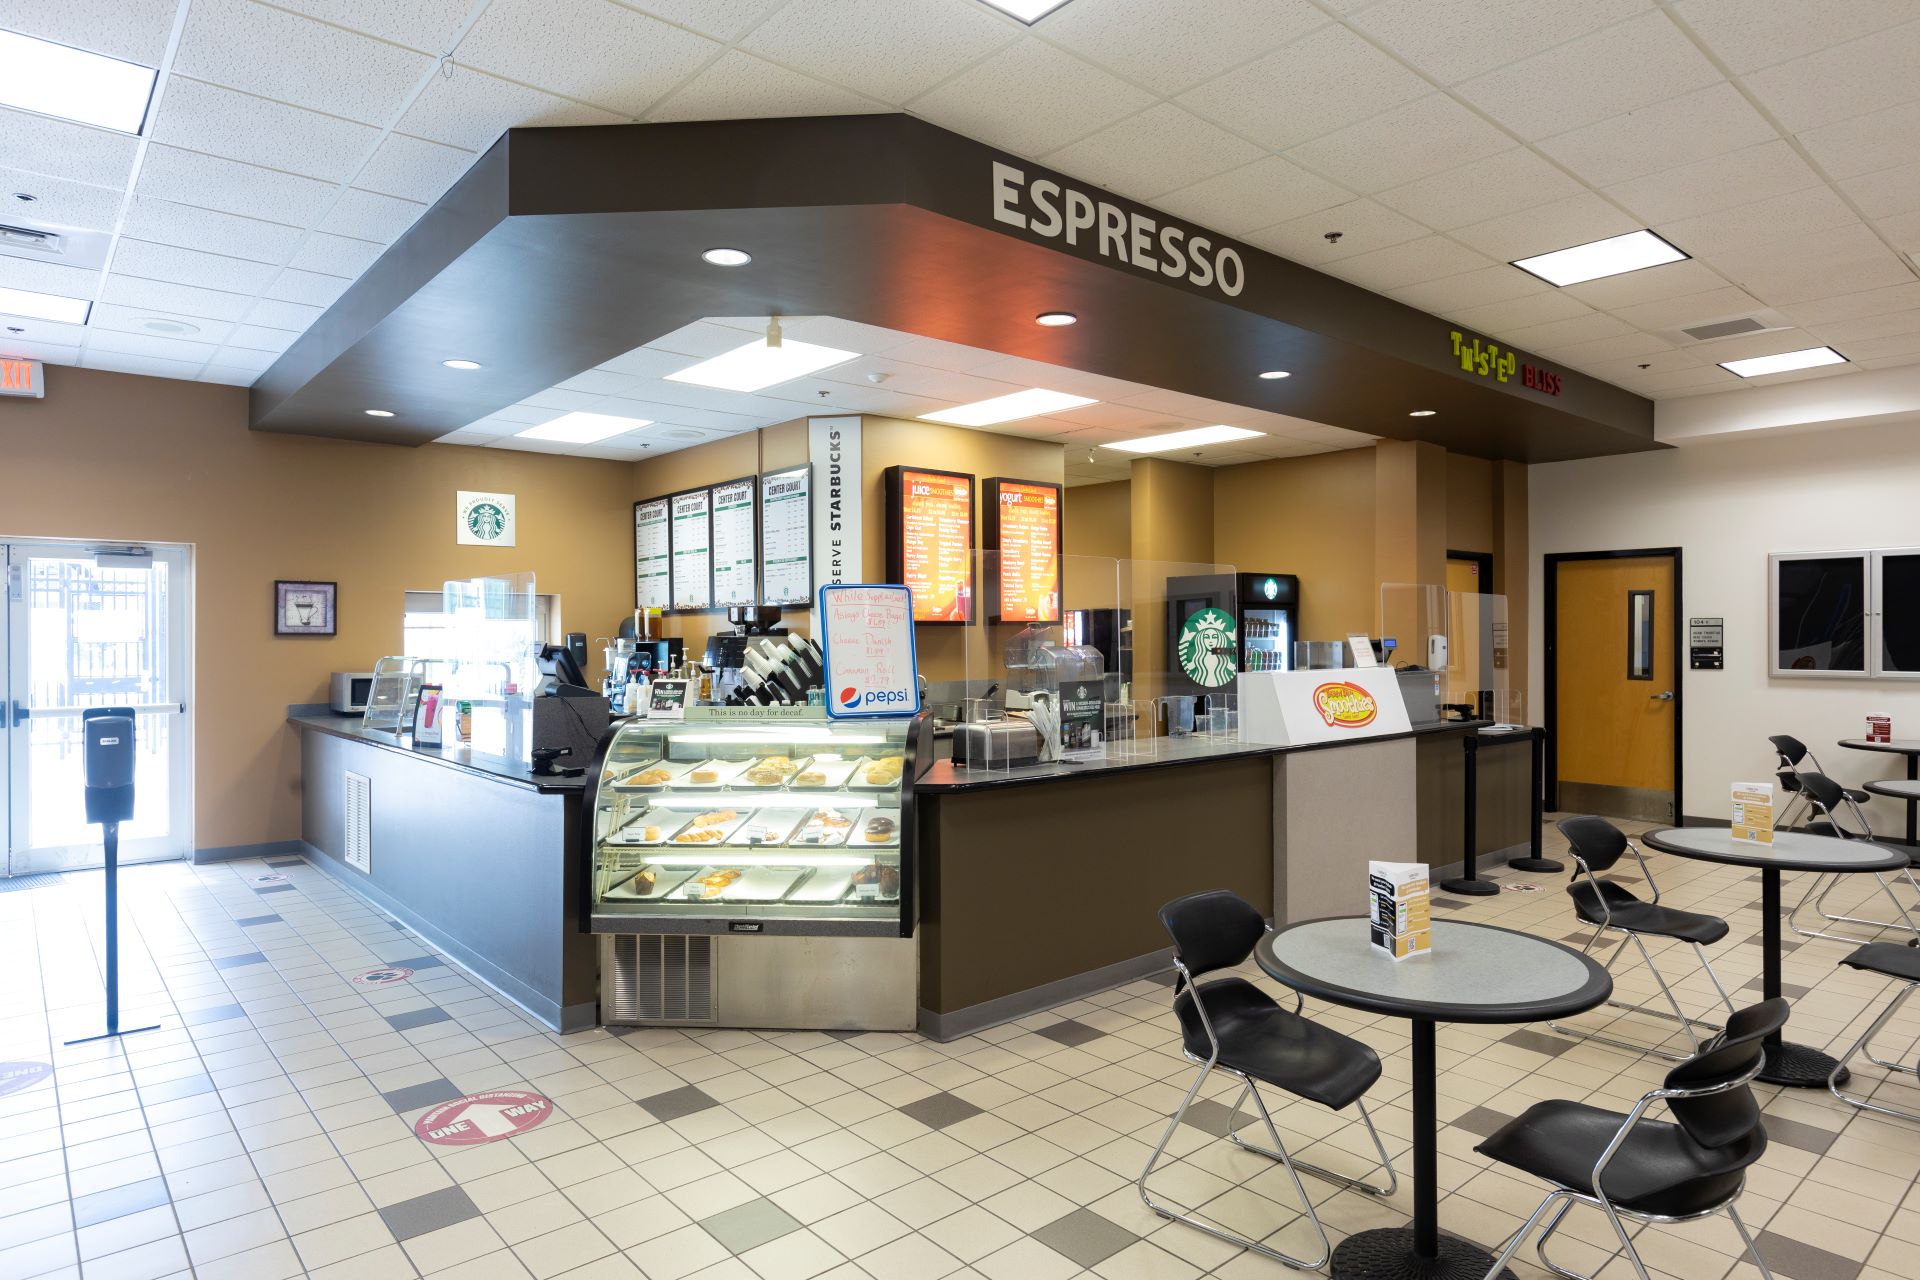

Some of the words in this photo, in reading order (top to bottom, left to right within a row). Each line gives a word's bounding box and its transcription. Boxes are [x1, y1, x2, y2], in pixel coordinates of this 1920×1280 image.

[993, 161, 1245, 297] ESPRESSO
[1450, 331, 1516, 383] TWISTED
[1522, 364, 1561, 396] BLISS
[0, 360, 32, 391] XIT
[768, 483, 786, 496] CENTER
[786, 480, 801, 493] COURT
[829, 430, 842, 531] STARBUCKS
[911, 480, 930, 499] juice
[717, 492, 733, 505] CENTER
[733, 490, 747, 502] COURT
[1000, 492, 1023, 506] yogurt
[677, 503, 691, 514] CENTER
[691, 501, 703, 511] COURT
[865, 688, 908, 706] pepsi
[708, 708, 727, 717] This
[729, 708, 737, 717] is
[749, 708, 766, 719] day
[767, 708, 779, 717] for
[780, 708, 804, 717] decaf.
[1063, 701, 1076, 712] WIN
[428, 1120, 472, 1139] ONE
[503, 1100, 547, 1118] WAY
